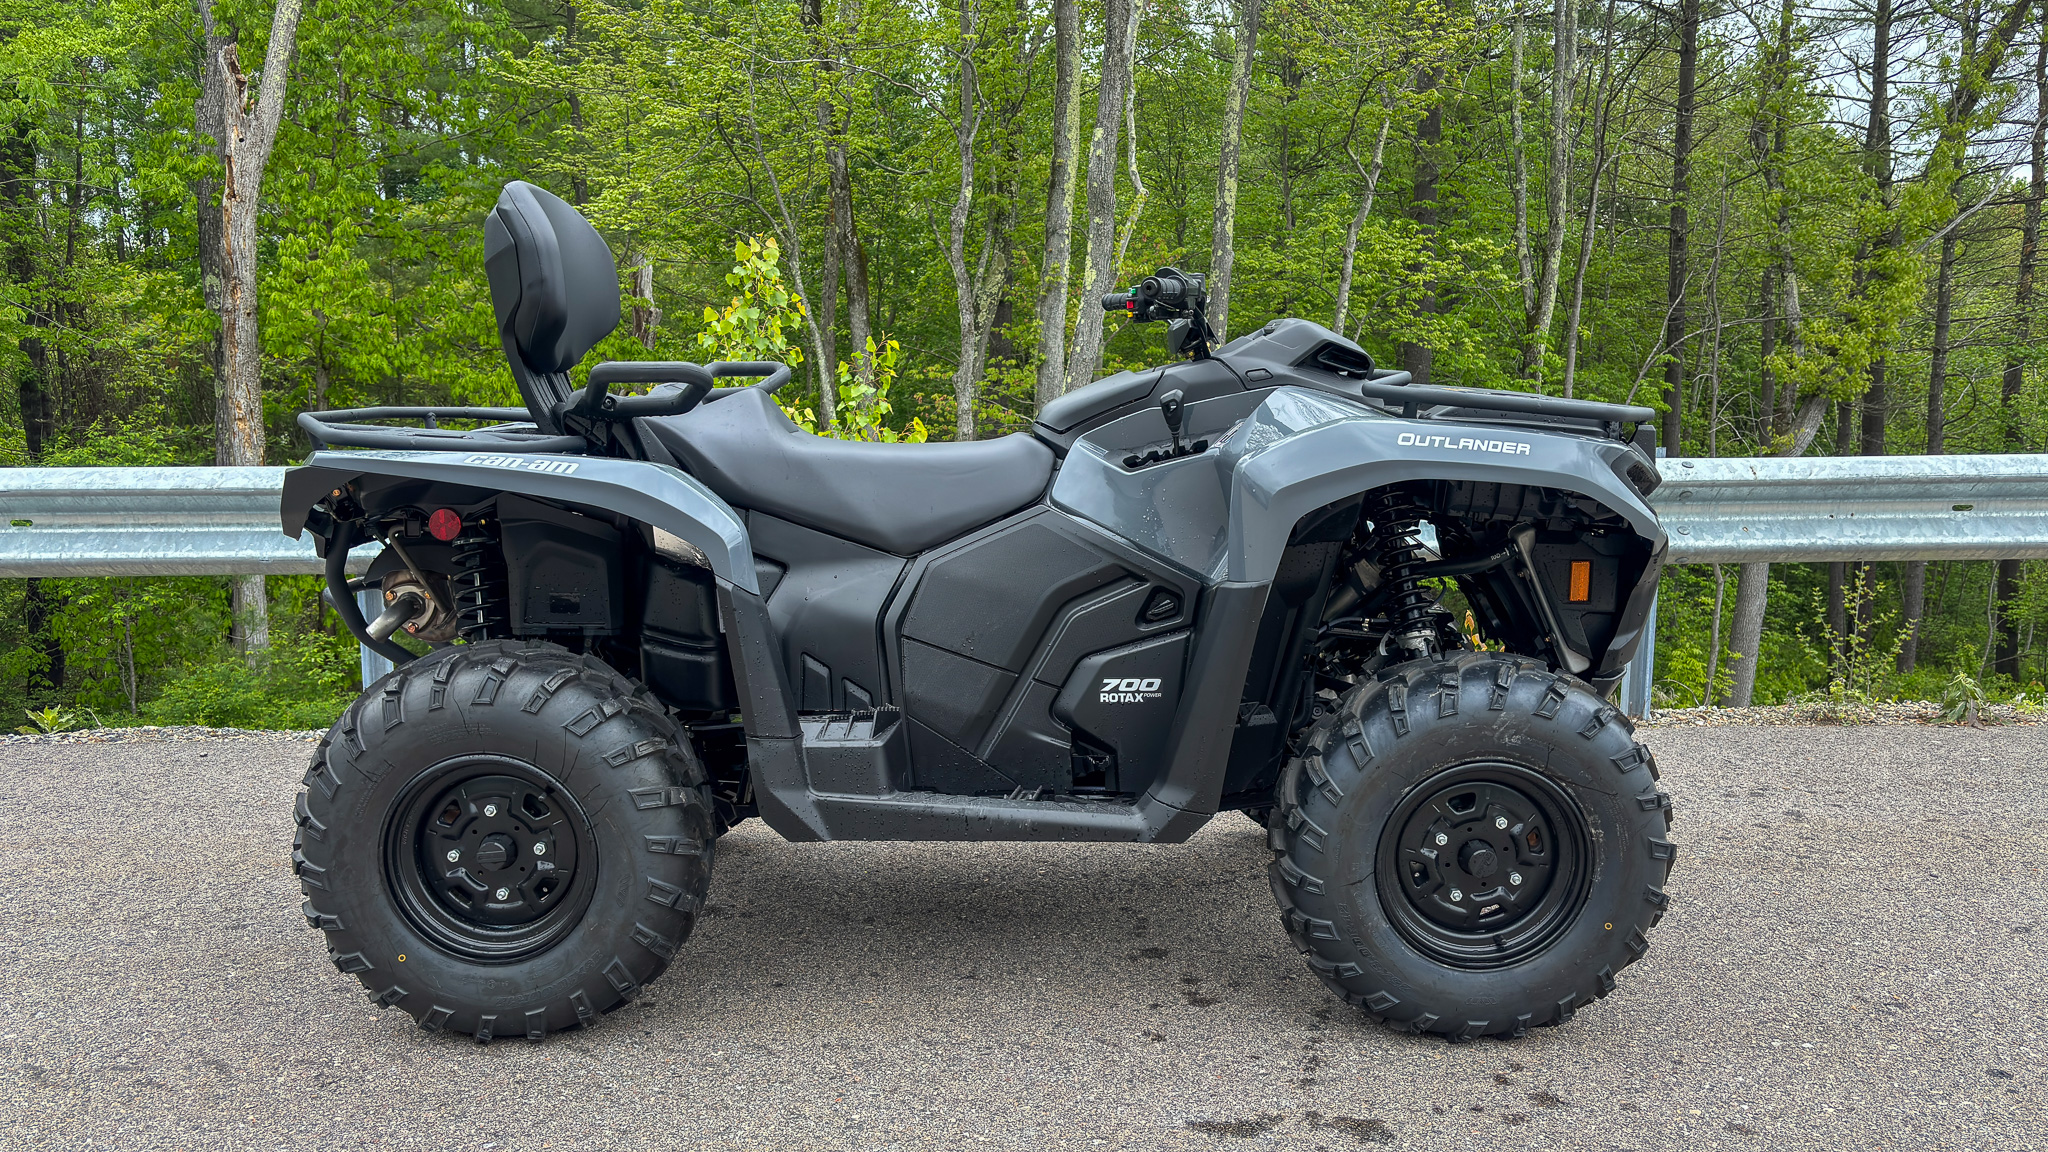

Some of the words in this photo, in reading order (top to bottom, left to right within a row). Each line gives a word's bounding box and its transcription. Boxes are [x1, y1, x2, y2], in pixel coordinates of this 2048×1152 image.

[1397, 432, 1531, 455] OUTLANDER
[463, 455, 580, 474] can-am
[1100, 678, 1162, 691] 700
[1100, 692, 1144, 703] ROTAX
